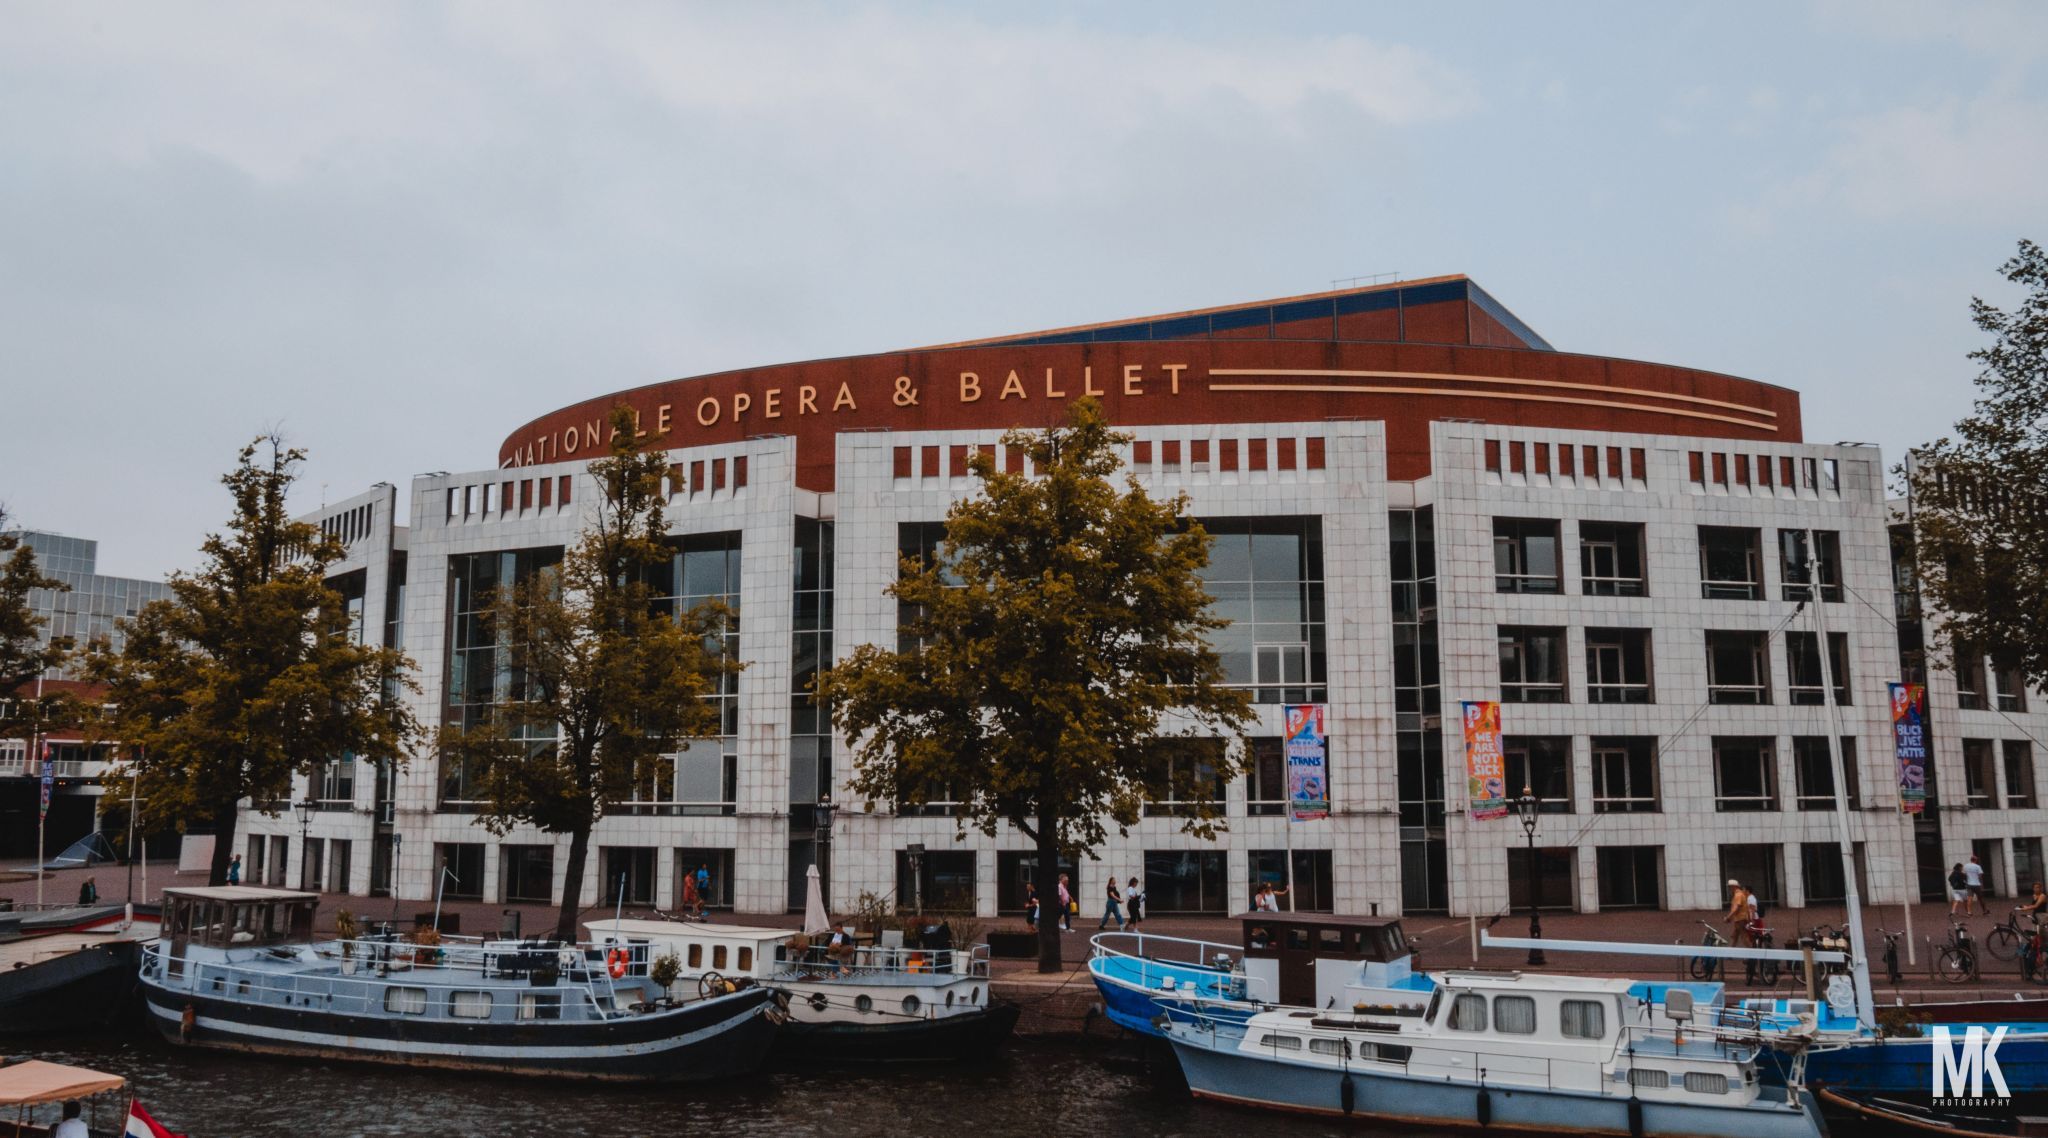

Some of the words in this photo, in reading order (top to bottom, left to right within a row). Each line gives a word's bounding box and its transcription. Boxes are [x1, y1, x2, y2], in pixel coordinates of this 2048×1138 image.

[697, 381, 857, 426] OPERA
[892, 376, 919, 407] &
[960, 364, 1187, 402] BALLET
[1475, 731, 1492, 742] WE
[1474, 742, 1495, 753] ARE
[1897, 747, 1925, 758] MATTR
[1472, 752, 1499, 764] NOT
